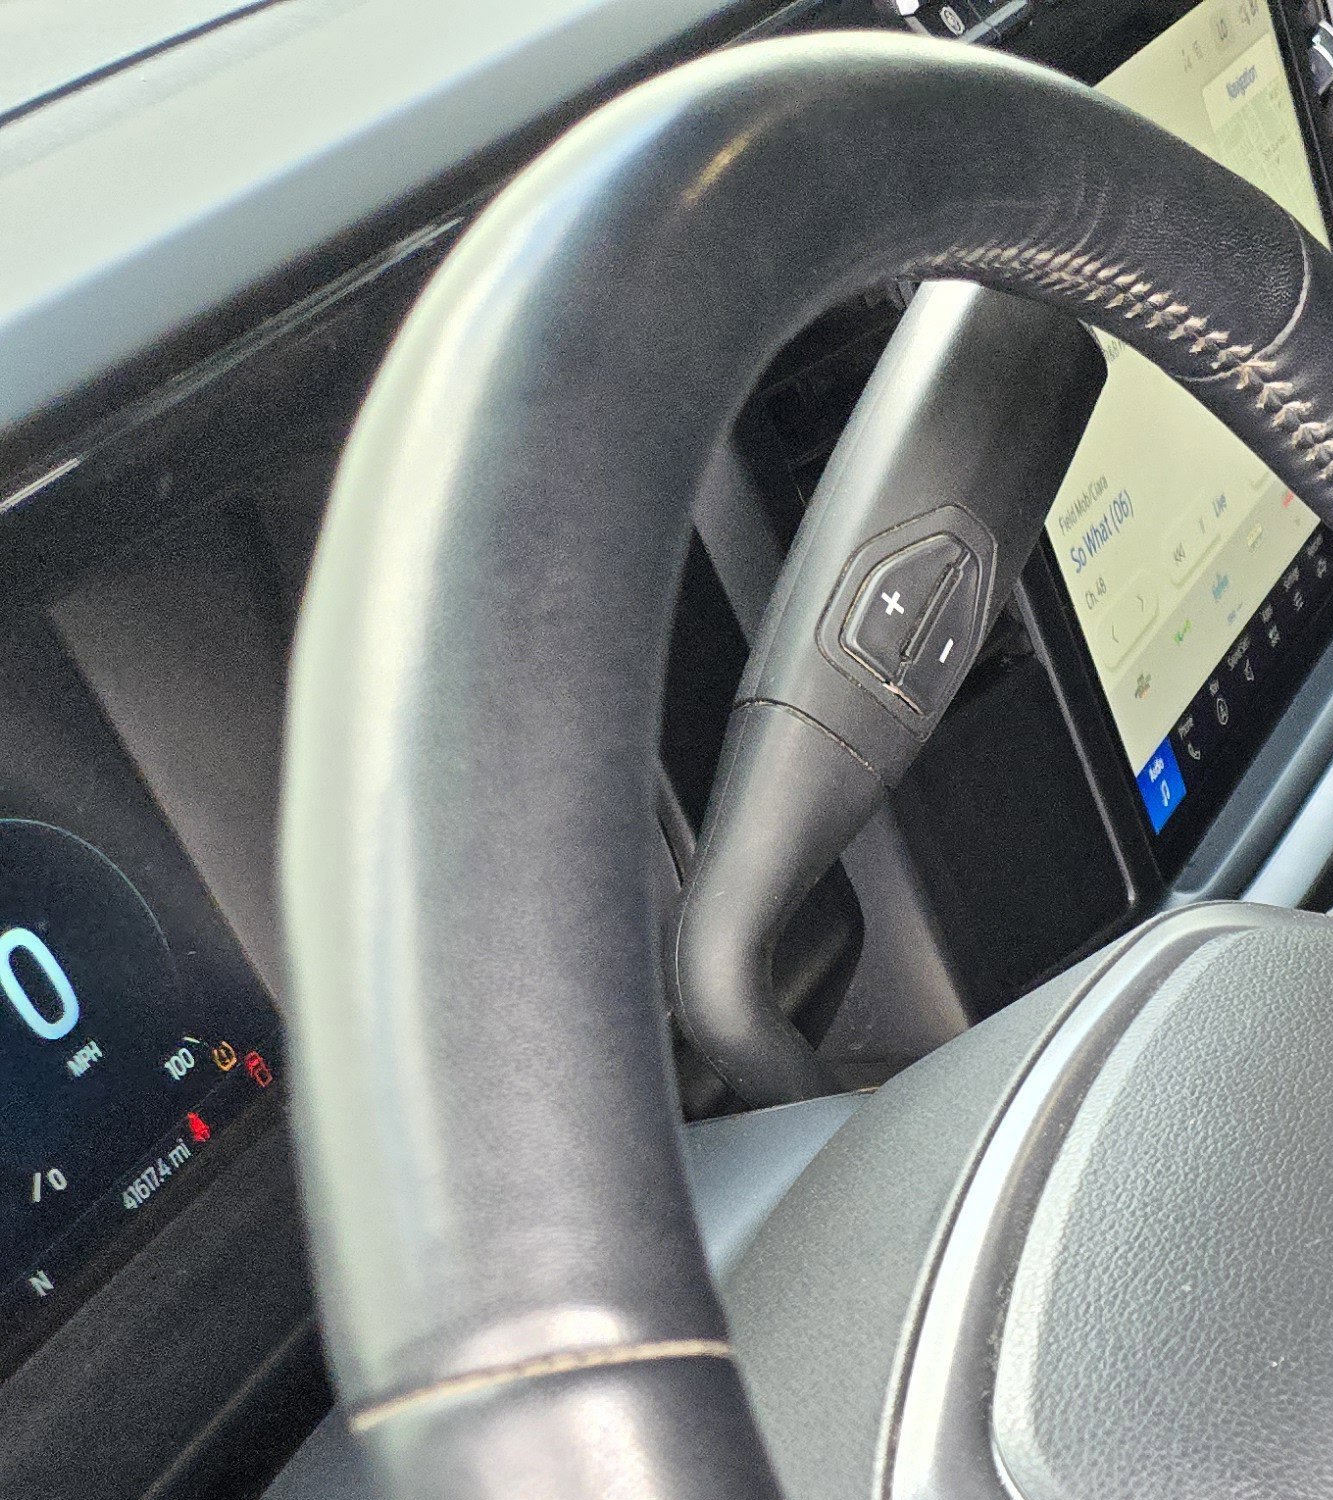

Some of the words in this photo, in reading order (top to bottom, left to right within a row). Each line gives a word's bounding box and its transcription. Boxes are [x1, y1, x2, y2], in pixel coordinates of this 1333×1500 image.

[1070, 547, 1087, 574] So
[1082, 513, 1113, 558] What
[0, 926, 80, 1040] 0
[66, 1040, 103, 1077] MPH
[164, 1048, 195, 1081] 100
[168, 1142, 192, 1168] mi
[28, 1269, 54, 1297] N
